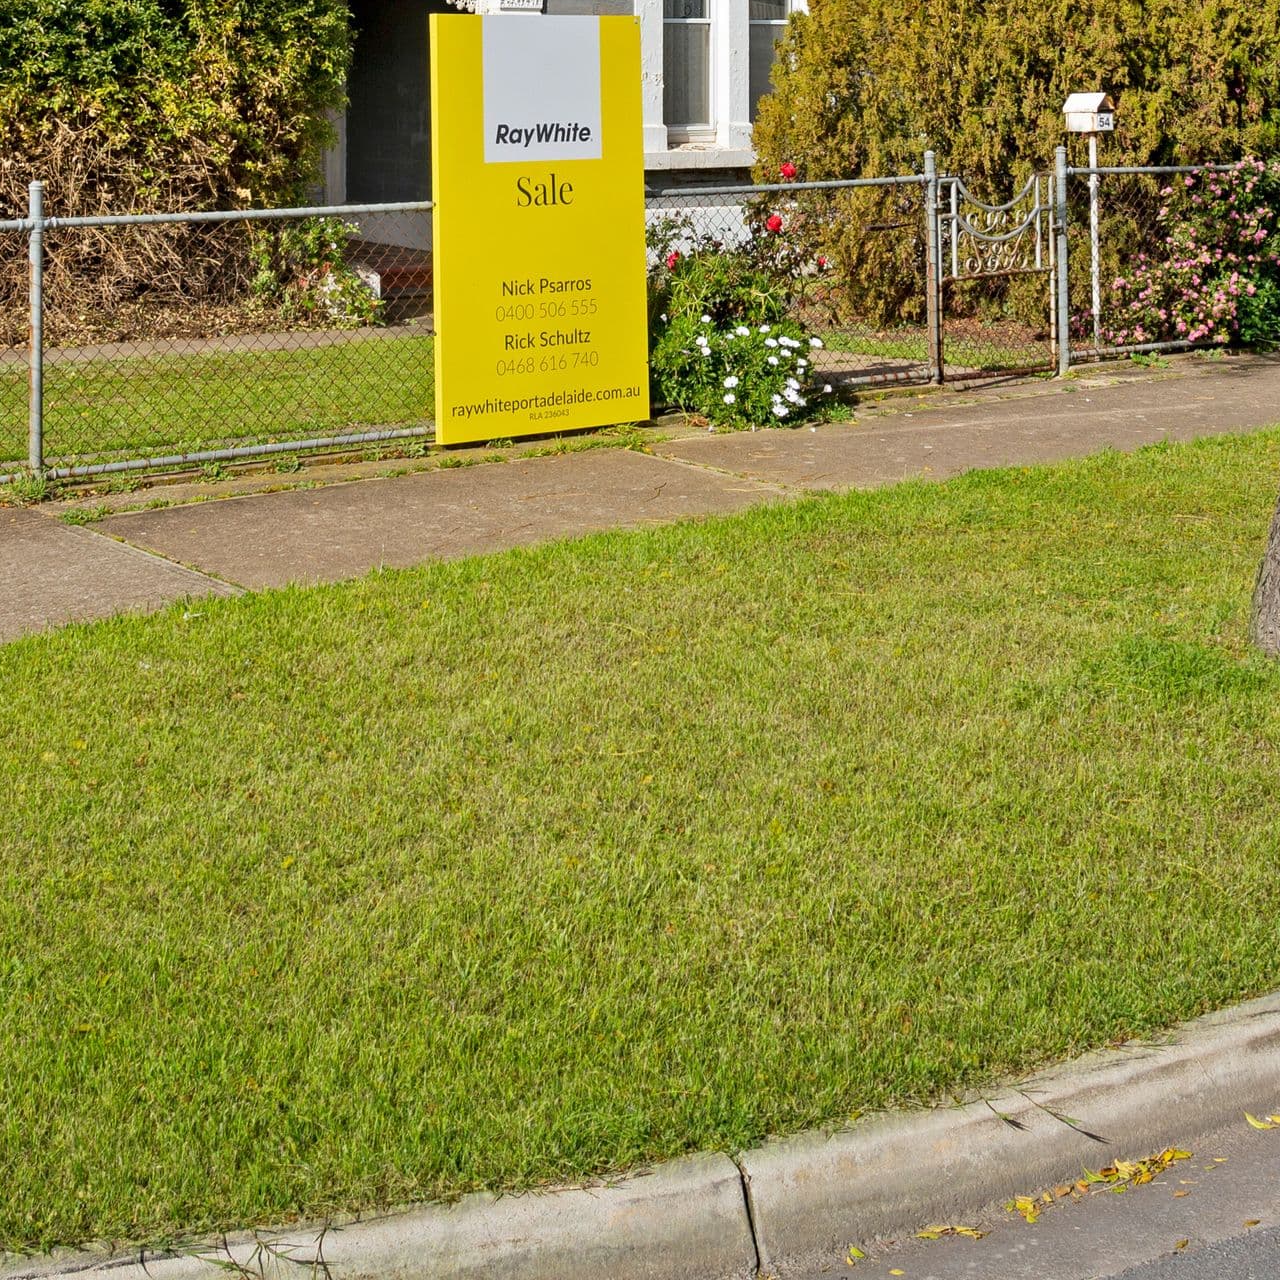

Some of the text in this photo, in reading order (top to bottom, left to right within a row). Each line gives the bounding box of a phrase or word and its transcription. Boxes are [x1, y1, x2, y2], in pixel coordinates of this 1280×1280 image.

[1099, 117, 1110, 128] 54
[517, 173, 573, 207] Sale
[502, 278, 592, 297] Nick Psarros
[495, 298, 598, 322] 0400 506 555
[504, 328, 591, 351] Rick Schultz
[496, 350, 599, 376] 0468 616 740
[451, 386, 641, 419] raywhiteportadelaide.com.au
[529, 412, 544, 421] RLA
